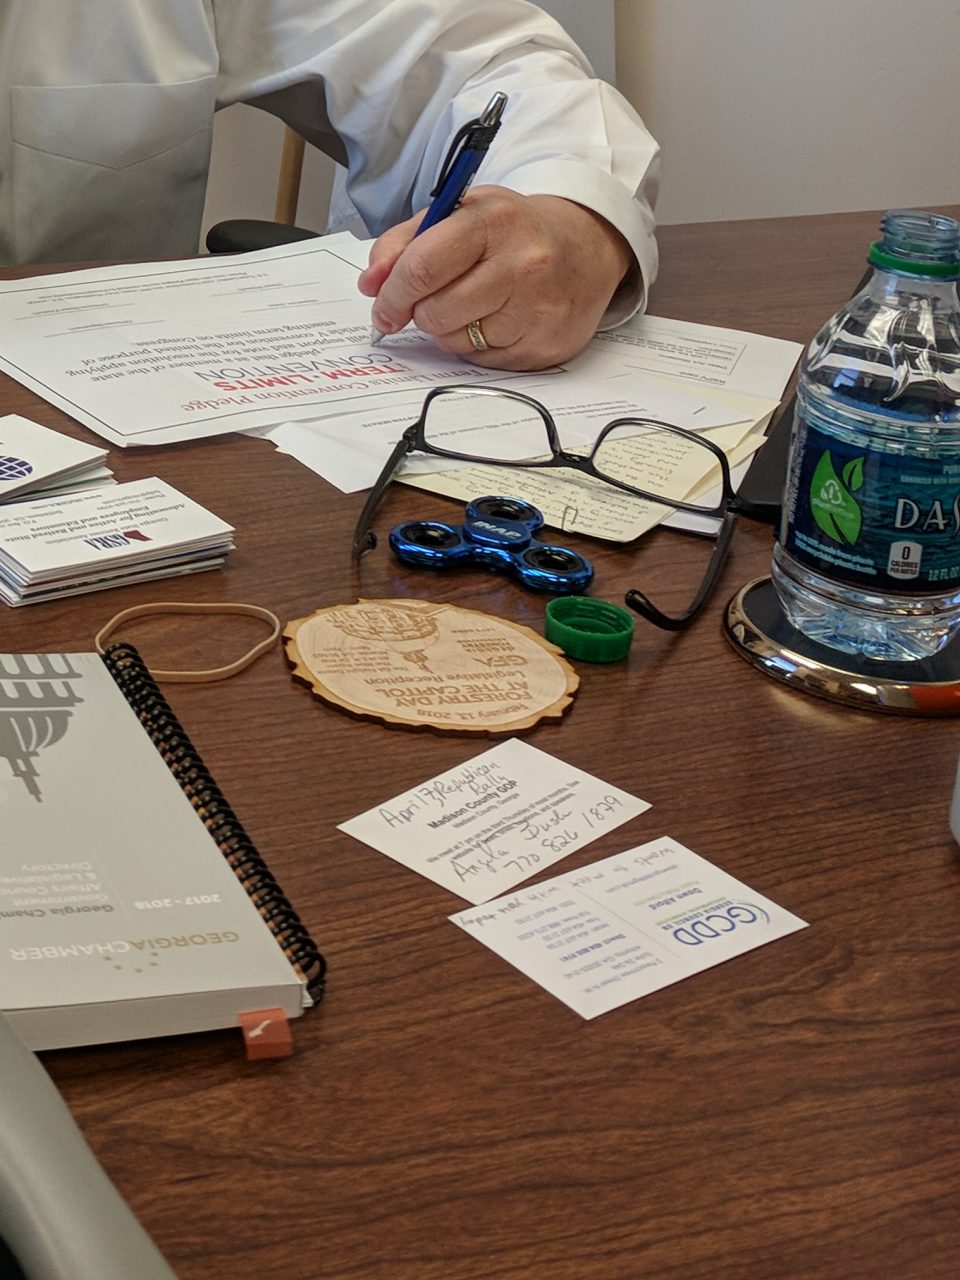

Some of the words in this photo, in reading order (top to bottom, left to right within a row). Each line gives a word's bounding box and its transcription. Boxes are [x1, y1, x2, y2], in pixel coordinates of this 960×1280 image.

[283, 320, 336, 331] enacting
[328, 325, 369, 337] Article
[215, 331, 250, 341] limits
[253, 328, 283, 337] term
[227, 339, 246, 348] for
[247, 333, 314, 346] convention
[298, 337, 345, 348] support
[154, 344, 202, 355] limited
[202, 343, 225, 351] the
[222, 348, 241, 356] for
[242, 346, 270, 354] vote
[271, 343, 296, 353] and
[99, 349, 152, 361] purpose
[129, 352, 195, 366] resolution
[197, 351, 219, 359] the
[81, 359, 96, 367] of
[152, 364, 166, 373] of
[169, 358, 221, 369] member
[194, 352, 393, 382] CONVENTION
[65, 362, 126, 377] applying
[127, 367, 150, 375] the
[321, 362, 400, 381] TERM
[440, 368, 488, 382] Term
[90, 372, 125, 382] state
[212, 371, 309, 391] LIMITS
[371, 372, 438, 389] Limits
[252, 379, 369, 404] Convention
[181, 392, 252, 414] Pledge
[902, 546, 911, 560] 0
[890, 560, 918, 569] CALORIES
[928, 569, 939, 581] 12
[940, 569, 948, 580] FL
[472, 655, 529, 667] GFA
[363, 675, 444, 686] Reception
[446, 670, 526, 681] Legislative
[461, 683, 504, 694] THE
[507, 681, 529, 691] AT
[376, 686, 460, 699] CAPITOL
[438, 691, 533, 705] FORESTRY
[394, 697, 433, 708] DAY
[427, 806, 469, 829] Madison
[465, 790, 500, 810] County
[496, 780, 518, 794] GOP
[503, 853, 540, 872] 770
[541, 830, 579, 852] 826
[580, 793, 624, 828] 1879
[19, 861, 93, 873] Directory
[0, 871, 81, 885] Legislative
[51, 883, 100, 895] Affairs
[12, 892, 109, 907] Government
[134, 898, 172, 910] 2018
[185, 894, 220, 905] 2017
[50, 904, 114, 916] Georgia
[672, 906, 757, 946] GCDD
